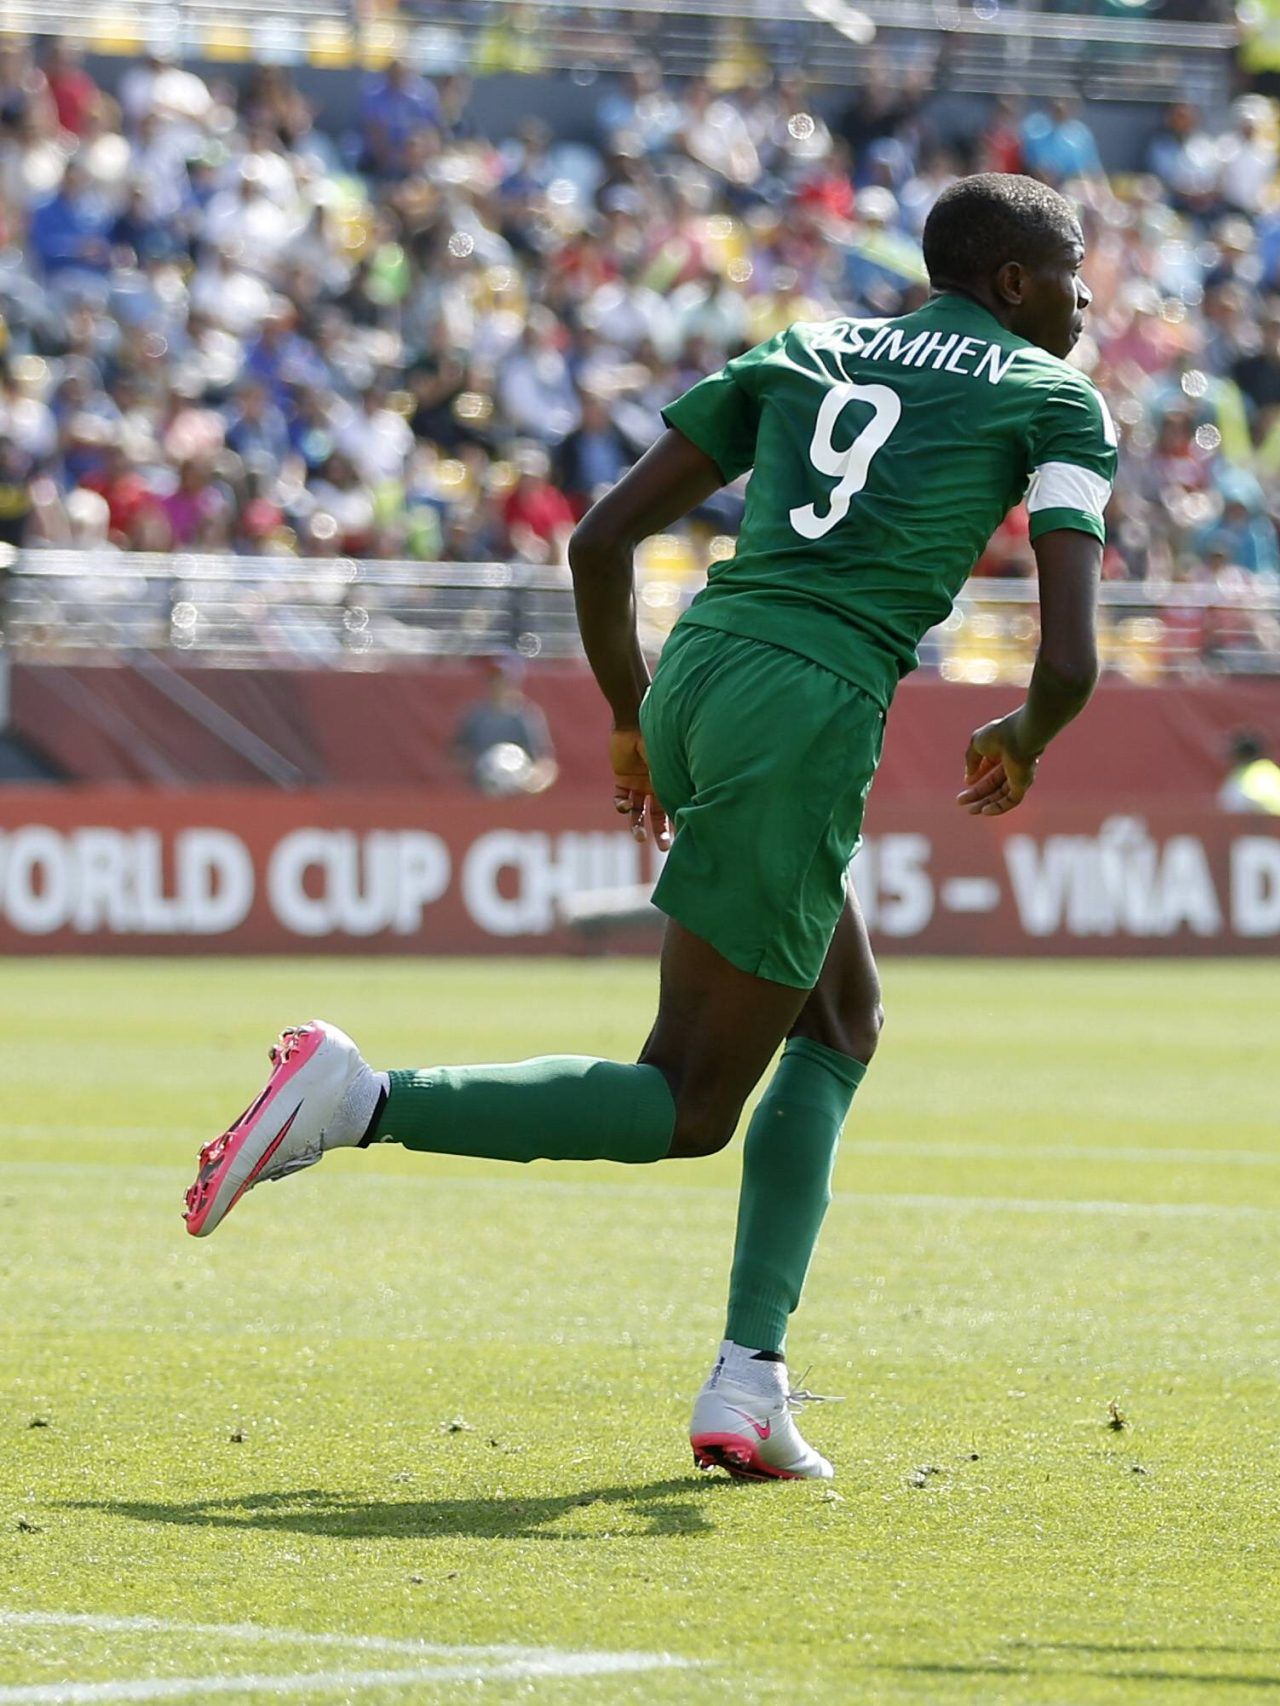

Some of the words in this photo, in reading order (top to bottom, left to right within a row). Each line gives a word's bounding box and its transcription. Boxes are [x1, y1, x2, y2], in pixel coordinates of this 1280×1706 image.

[789, 383, 901, 540] 9
[0, 825, 254, 936] ORLD
[267, 827, 451, 937] CUP
[460, 829, 669, 936] CHIL
[1005, 815, 1221, 938] VIÑA
